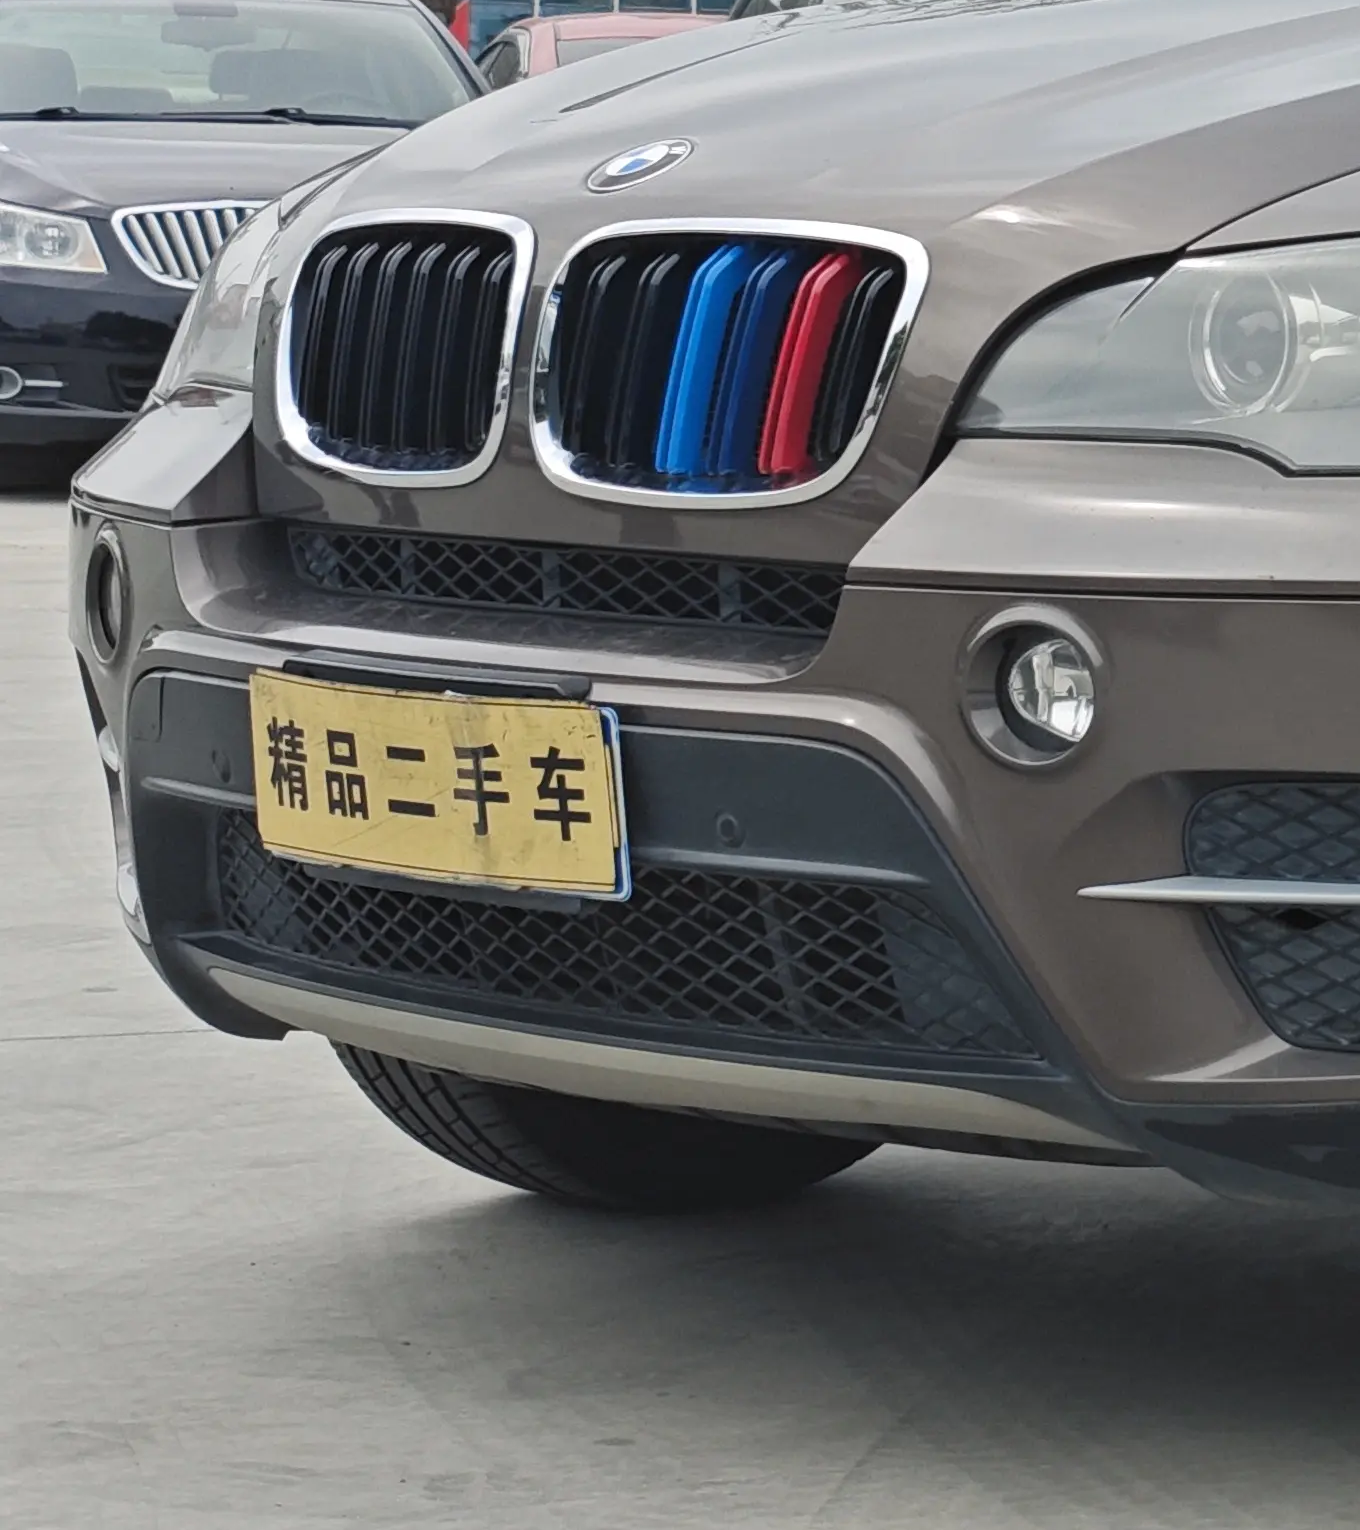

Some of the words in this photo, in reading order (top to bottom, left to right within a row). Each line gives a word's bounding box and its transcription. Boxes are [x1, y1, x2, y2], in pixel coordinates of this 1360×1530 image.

[267, 716, 592, 842] 精品二手车
